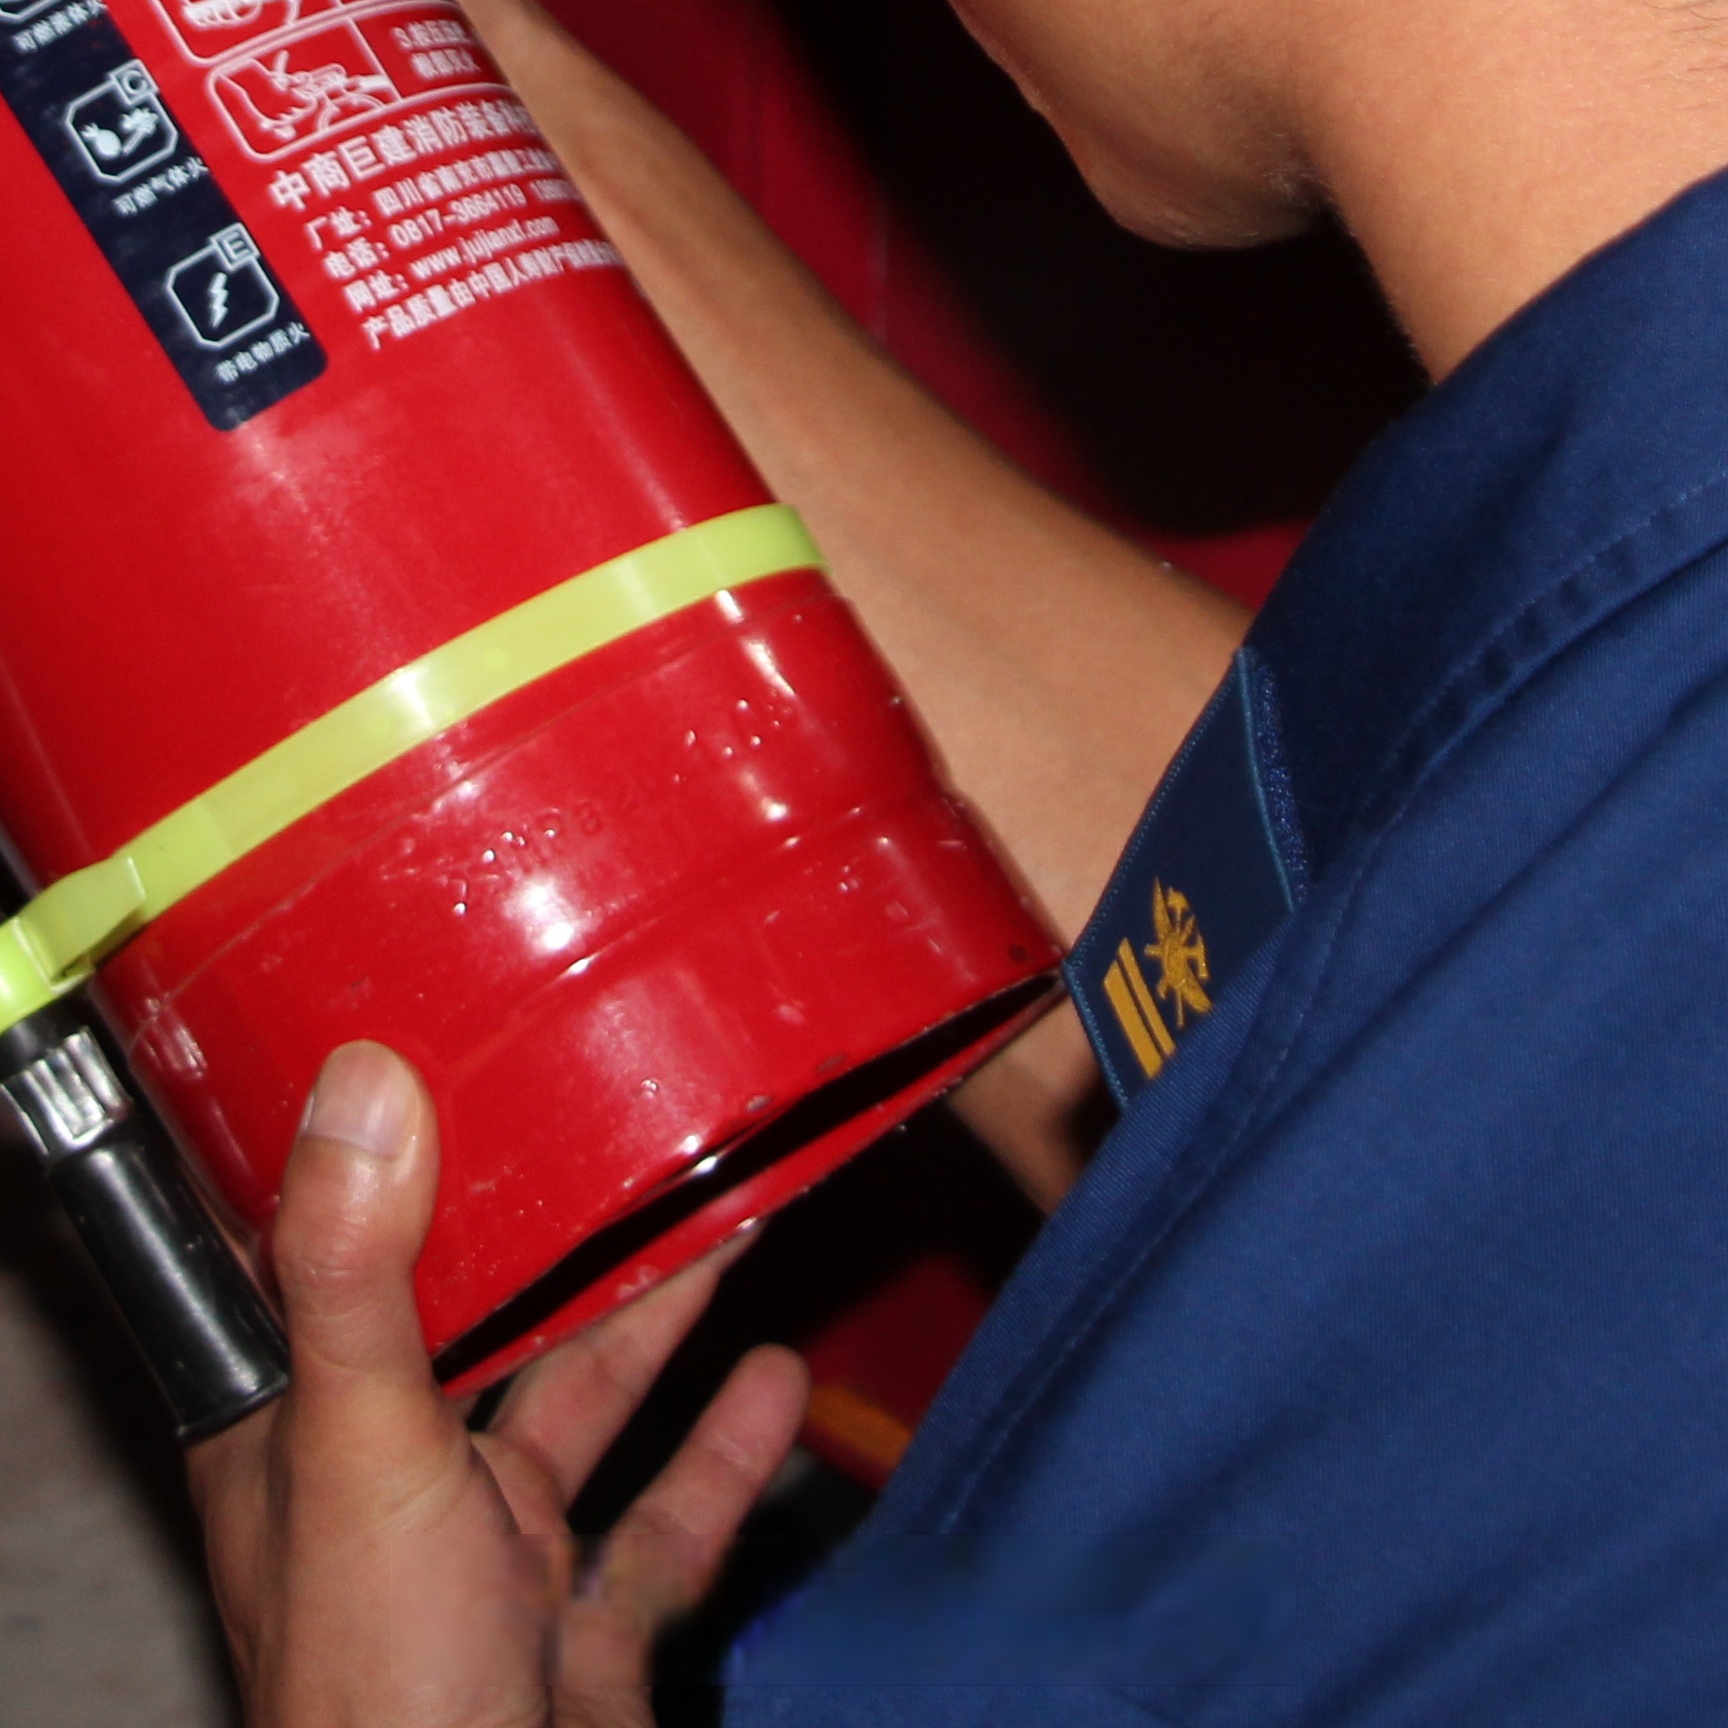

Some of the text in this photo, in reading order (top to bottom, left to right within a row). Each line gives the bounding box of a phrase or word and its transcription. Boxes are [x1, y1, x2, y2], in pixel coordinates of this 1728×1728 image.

[122, 70, 149, 97] C
[112, 157, 209, 216] 可燃气体火
[223, 231, 251, 260] E
[216, 322, 311, 385] 带电物质火
